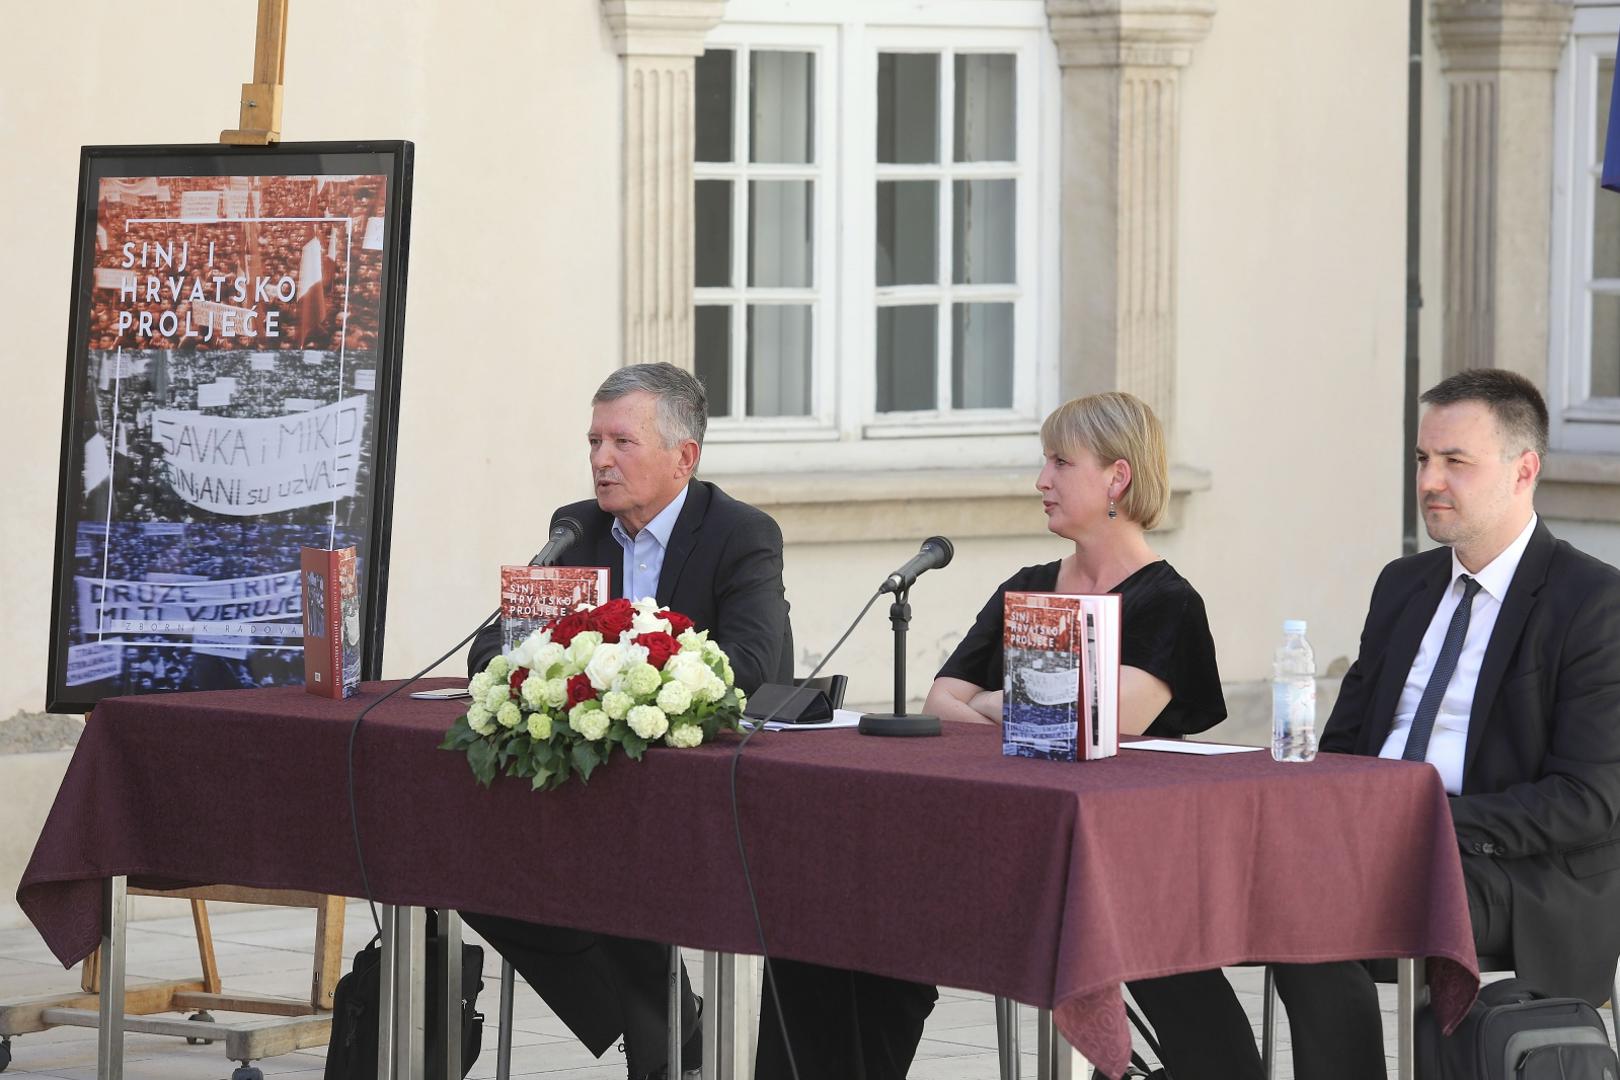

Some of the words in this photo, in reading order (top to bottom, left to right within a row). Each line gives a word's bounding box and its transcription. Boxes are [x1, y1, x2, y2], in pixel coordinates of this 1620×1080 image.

[121, 241, 190, 272] SINJ
[208, 241, 215, 267] I
[120, 276, 296, 302] HRVATSKO
[118, 304, 280, 342] PROLJEĆE
[158, 420, 250, 466] SAVKA
[510, 584, 534, 594] SINJ
[509, 594, 572, 606] HRVATSKO
[1010, 611, 1030, 623] SINJ
[125, 622, 208, 632] ZBORNIK
[225, 624, 298, 634] RADOVA
